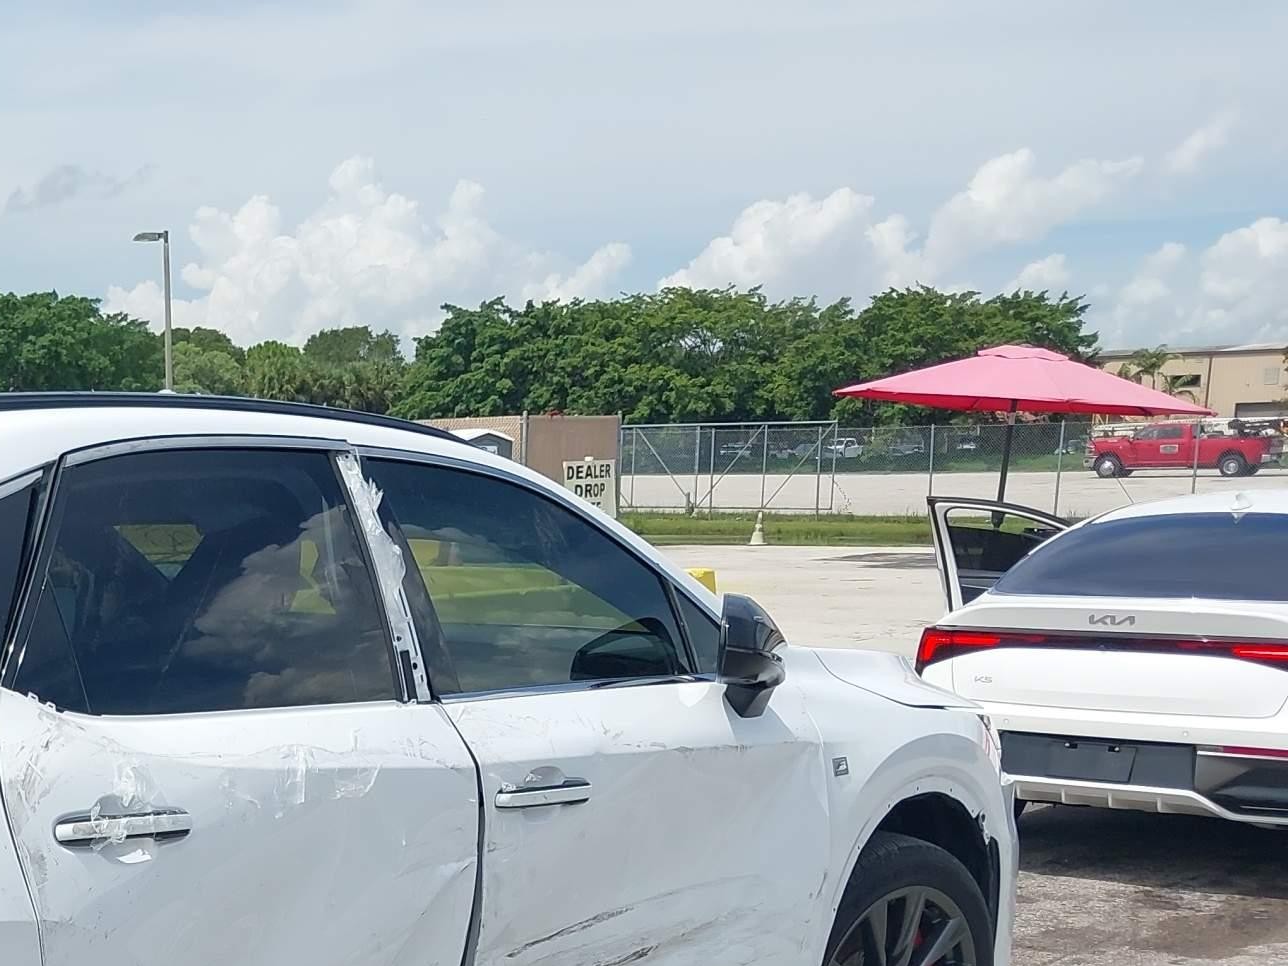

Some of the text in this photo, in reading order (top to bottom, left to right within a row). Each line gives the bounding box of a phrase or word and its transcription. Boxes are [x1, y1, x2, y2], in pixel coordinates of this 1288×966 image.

[567, 464, 611, 480] DEALER
[575, 483, 605, 498] DROP
[1089, 614, 1136, 626] KIA
[974, 675, 993, 683] K5
